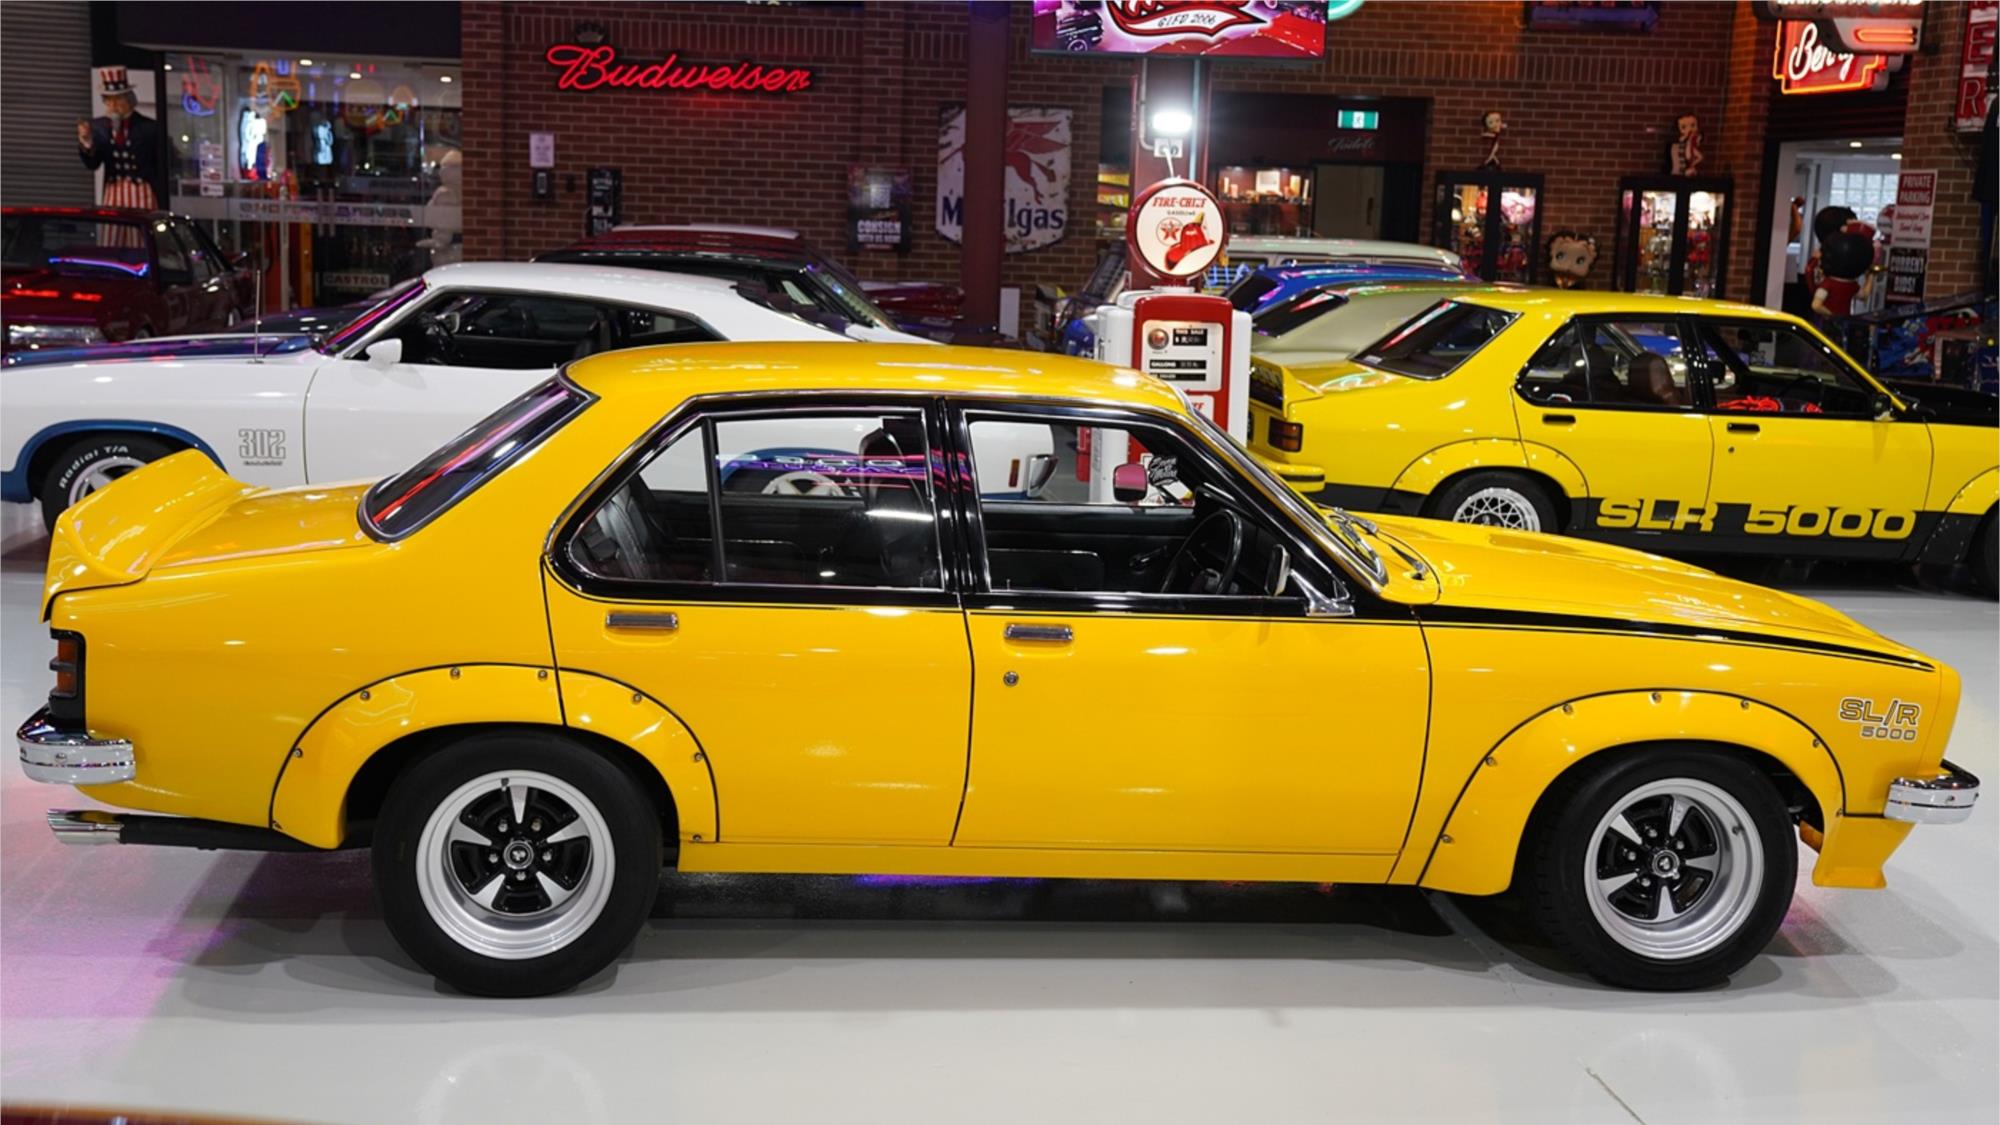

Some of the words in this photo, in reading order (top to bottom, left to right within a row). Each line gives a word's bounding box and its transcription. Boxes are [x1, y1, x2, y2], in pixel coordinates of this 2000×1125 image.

[546, 45, 811, 91] Budweiser
[1903, 175, 1932, 188] PRIVATE
[1900, 191, 1931, 204] PARKING
[857, 219, 901, 233] CONSIGN
[1890, 256, 1924, 273] CURRENT
[326, 274, 387, 287] CASTROL
[239, 429, 286, 459] 302
[58, 449, 99, 489] Radial
[103, 445, 129, 454] T/A
[1596, 498, 1718, 533] SLR
[1743, 503, 1916, 540] 5000
[1840, 698, 1920, 726] SL/R
[1861, 726, 1917, 741] 5000
